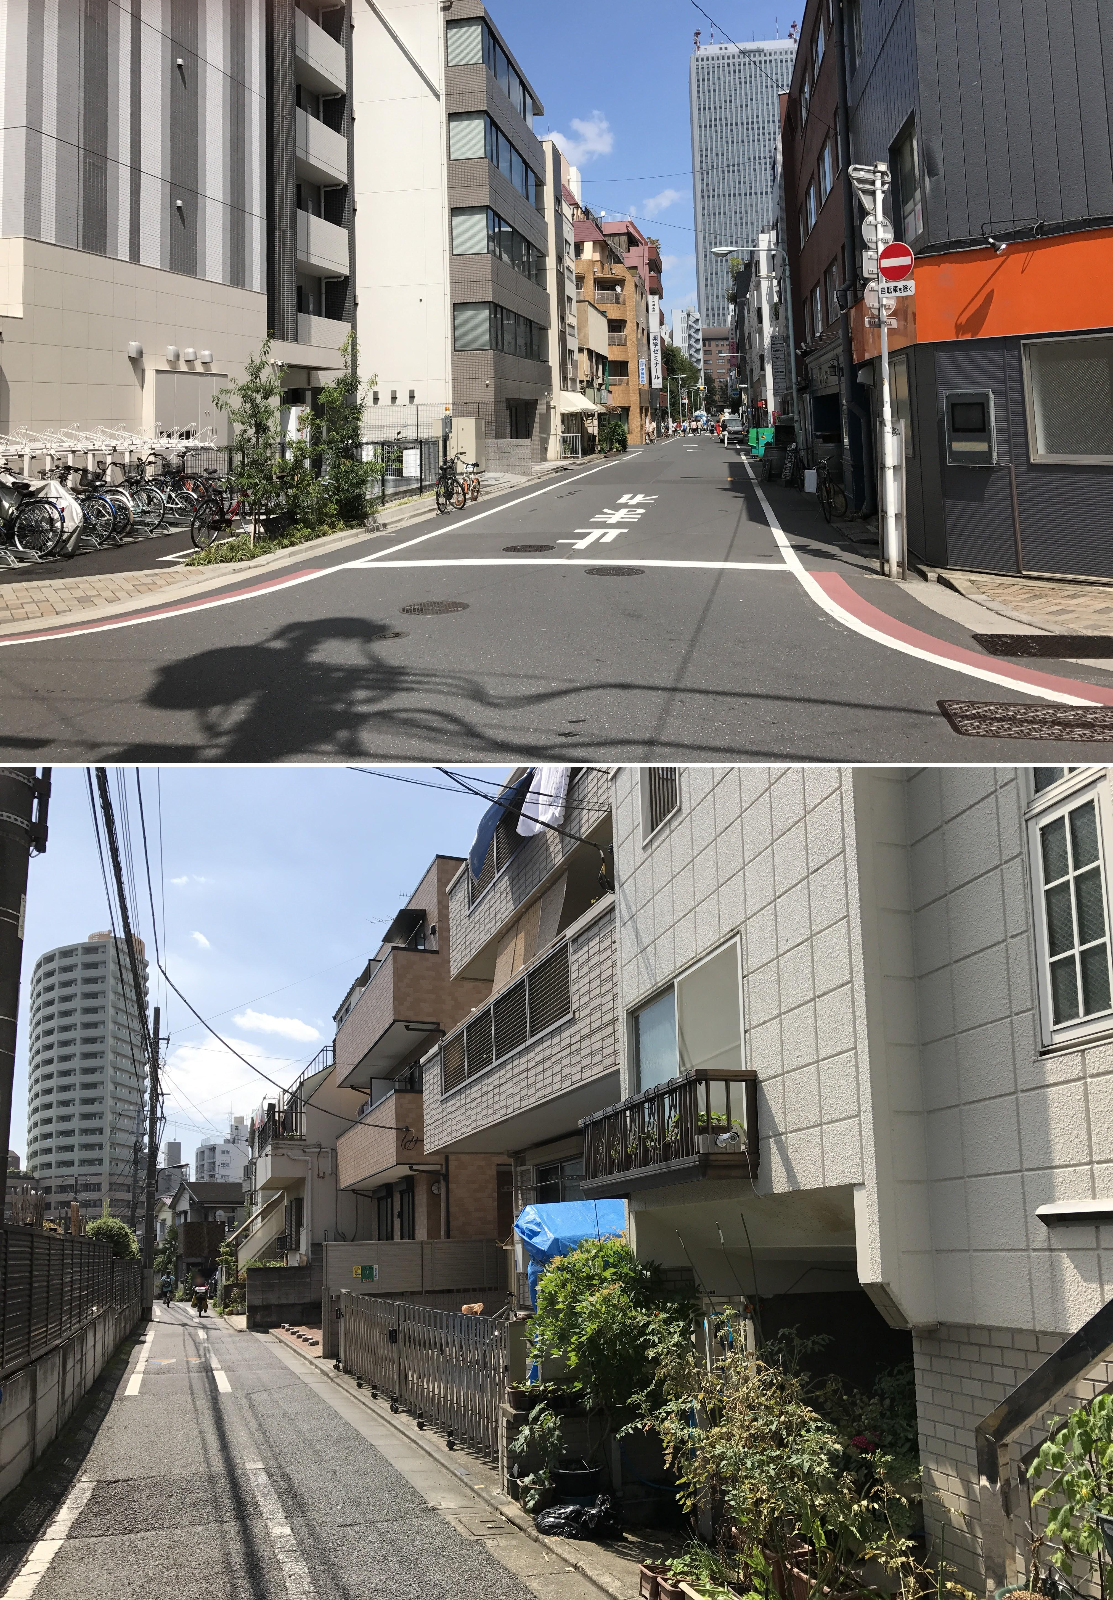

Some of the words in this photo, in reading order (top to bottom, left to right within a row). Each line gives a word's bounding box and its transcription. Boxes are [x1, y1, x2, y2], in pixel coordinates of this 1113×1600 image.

[880, 284, 913, 295] 自転車を除く
[556, 493, 660, 550] 止まれ
